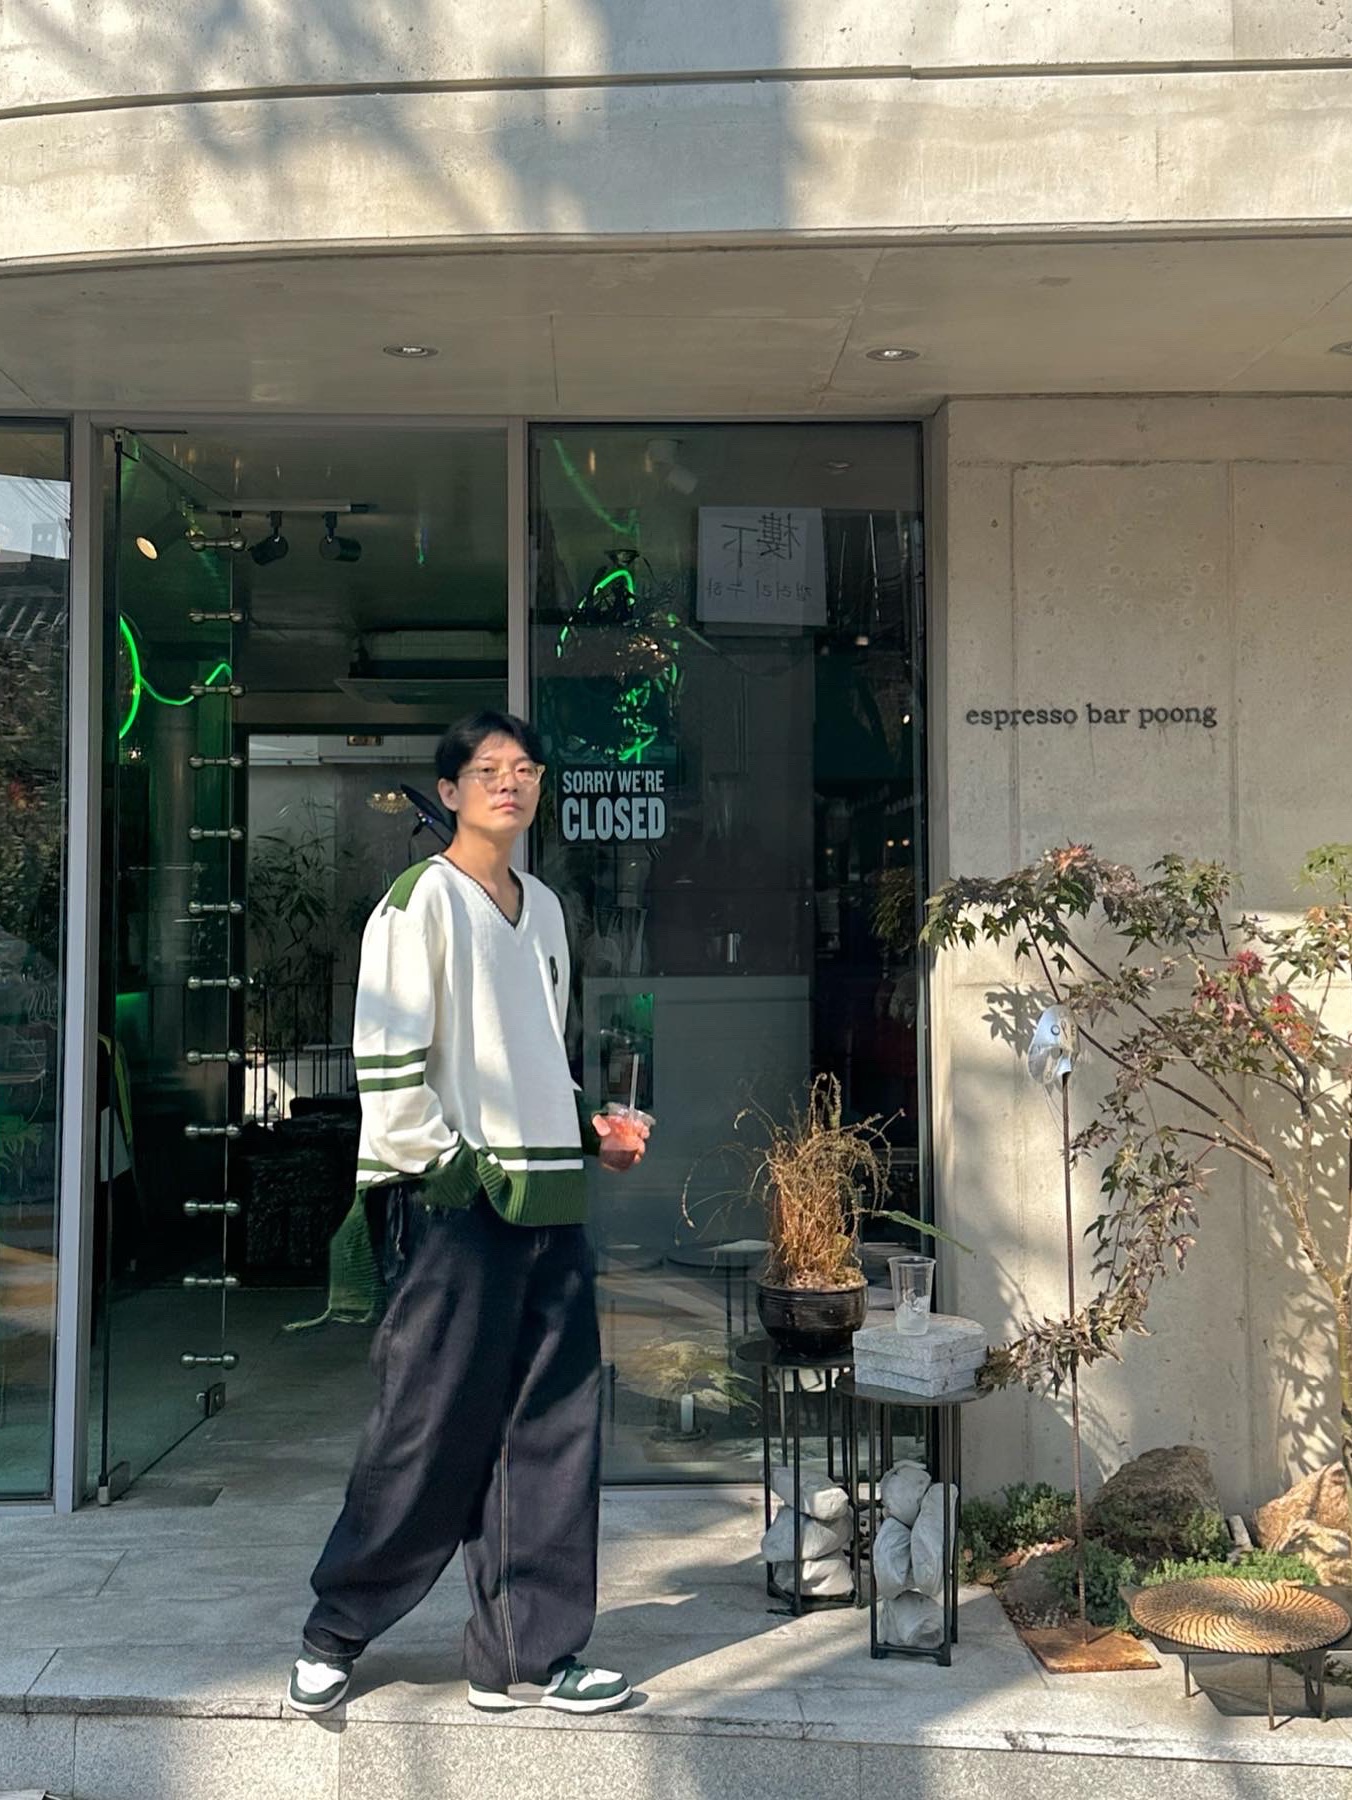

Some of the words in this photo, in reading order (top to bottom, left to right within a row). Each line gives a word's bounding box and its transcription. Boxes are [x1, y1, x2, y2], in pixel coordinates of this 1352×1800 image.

[965, 708, 1078, 730] espresso
[1085, 704, 1131, 724] bar
[1138, 705, 1218, 729] poong
[562, 770, 614, 794] SORRY
[617, 770, 665, 793] WE'RE
[562, 797, 666, 841] CLOSED
